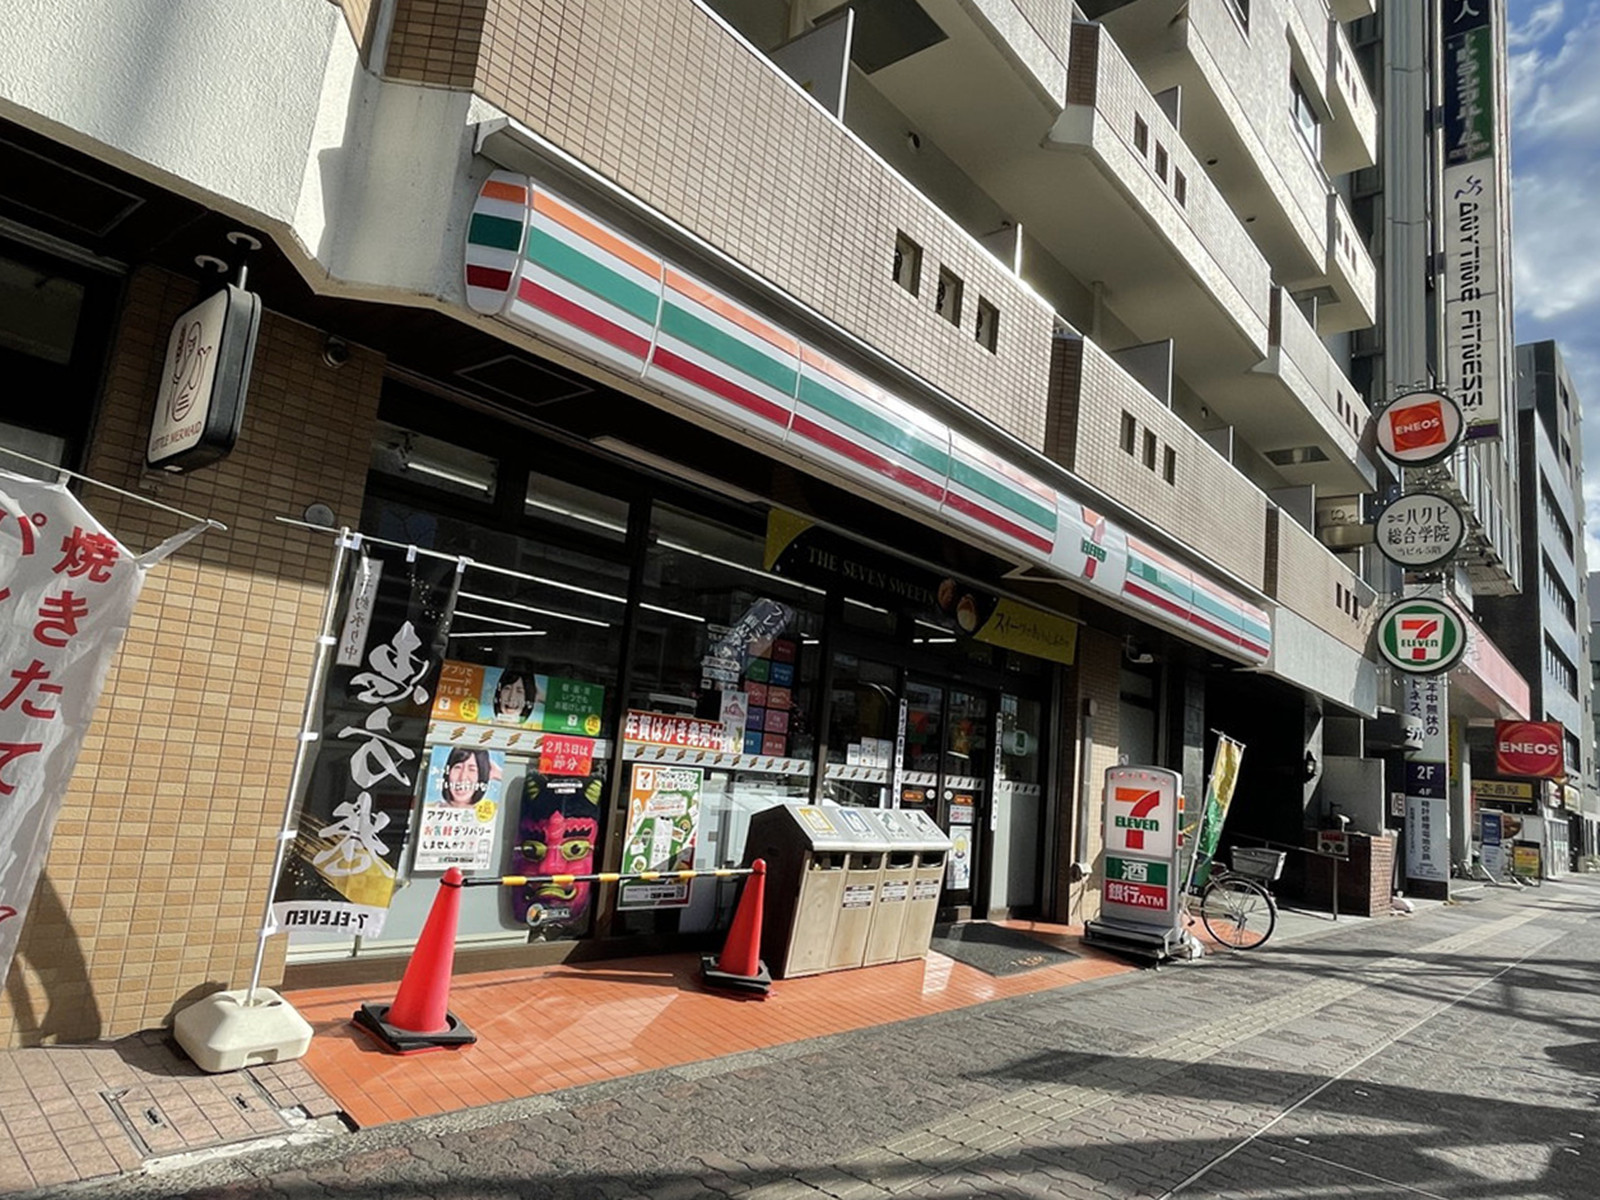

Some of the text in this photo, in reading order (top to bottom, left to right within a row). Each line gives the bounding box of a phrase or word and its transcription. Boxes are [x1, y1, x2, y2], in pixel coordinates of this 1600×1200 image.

[1459, 201, 1483, 407] ANYTIME FITNESS
[1395, 417, 1440, 436] ENEOS
[1405, 506, 1449, 525] ハクビ
[1387, 525, 1450, 545] 総合学院
[807, 547, 838, 572] THE
[625, 712, 722, 750] 年賀はがき発売中
[546, 741, 589, 756] 2月3日は
[1500, 742, 1560, 755] ENEOS
[1417, 765, 1435, 780] 2F
[426, 810, 461, 822] アプリで
[1121, 860, 1148, 882] 酒
[1108, 883, 1164, 908] 銀行ATM
